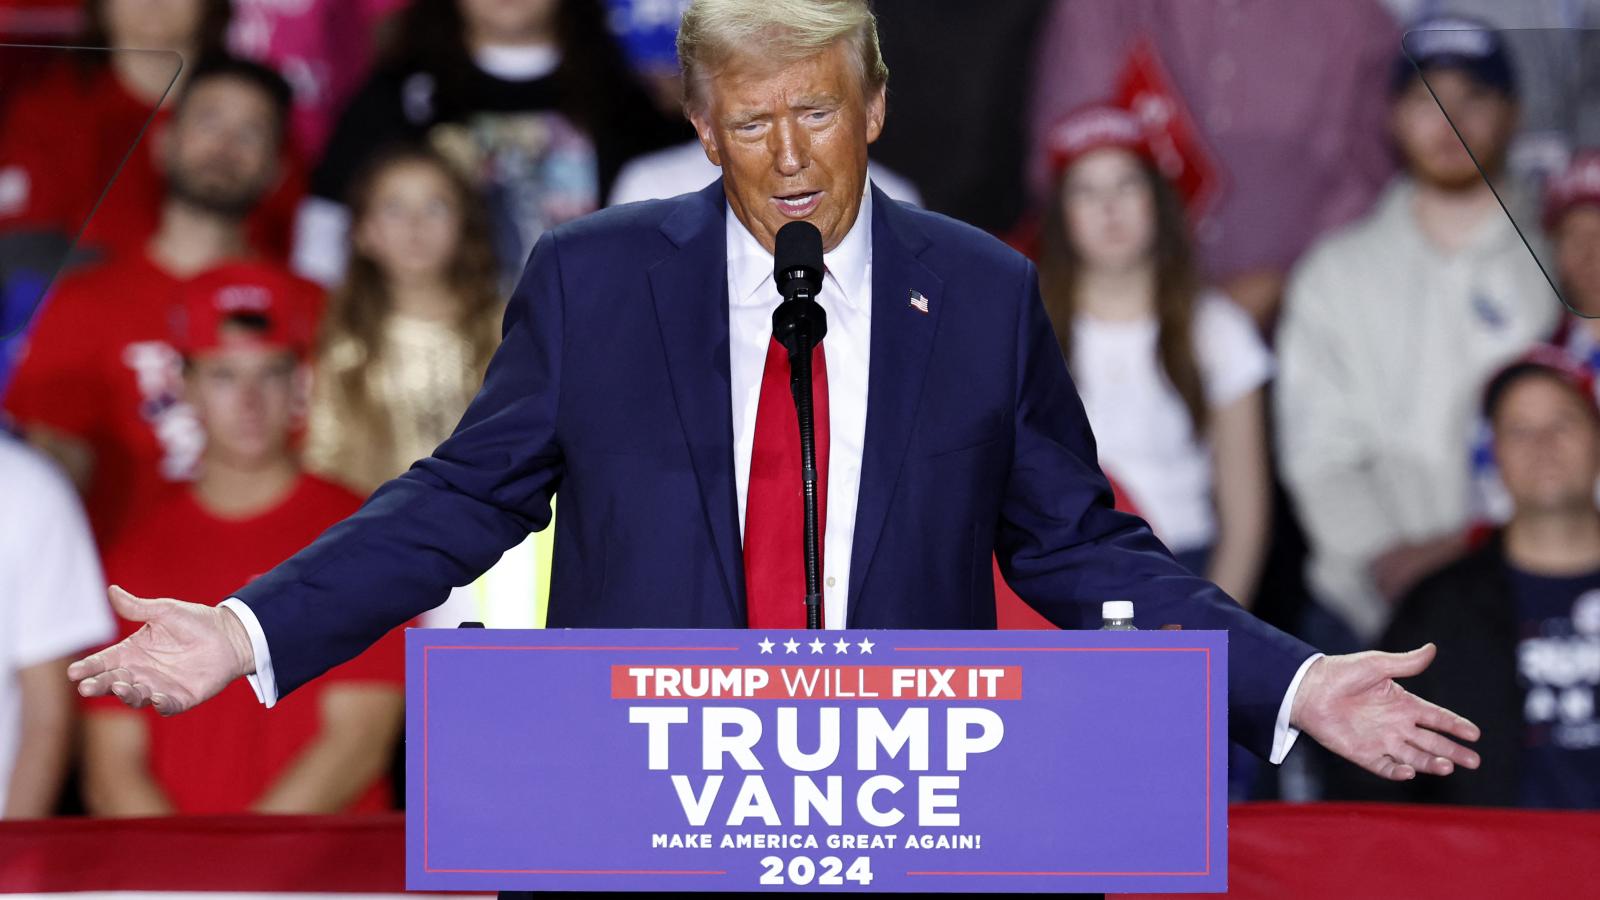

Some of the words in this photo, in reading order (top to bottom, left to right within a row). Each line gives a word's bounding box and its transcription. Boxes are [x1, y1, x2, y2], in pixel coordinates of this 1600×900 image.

[629, 668, 769, 697] TRUMP
[780, 668, 879, 697] WILL
[892, 668, 956, 697] FIX
[968, 668, 1005, 697] IT
[629, 706, 1005, 772] TRUMP
[670, 775, 960, 827] VANCE
[652, 833, 712, 849] MAKE
[720, 834, 819, 849] AMERICA
[826, 834, 897, 849] GREAT
[904, 834, 981, 849] AGAIN!
[759, 855, 874, 886] 2024
